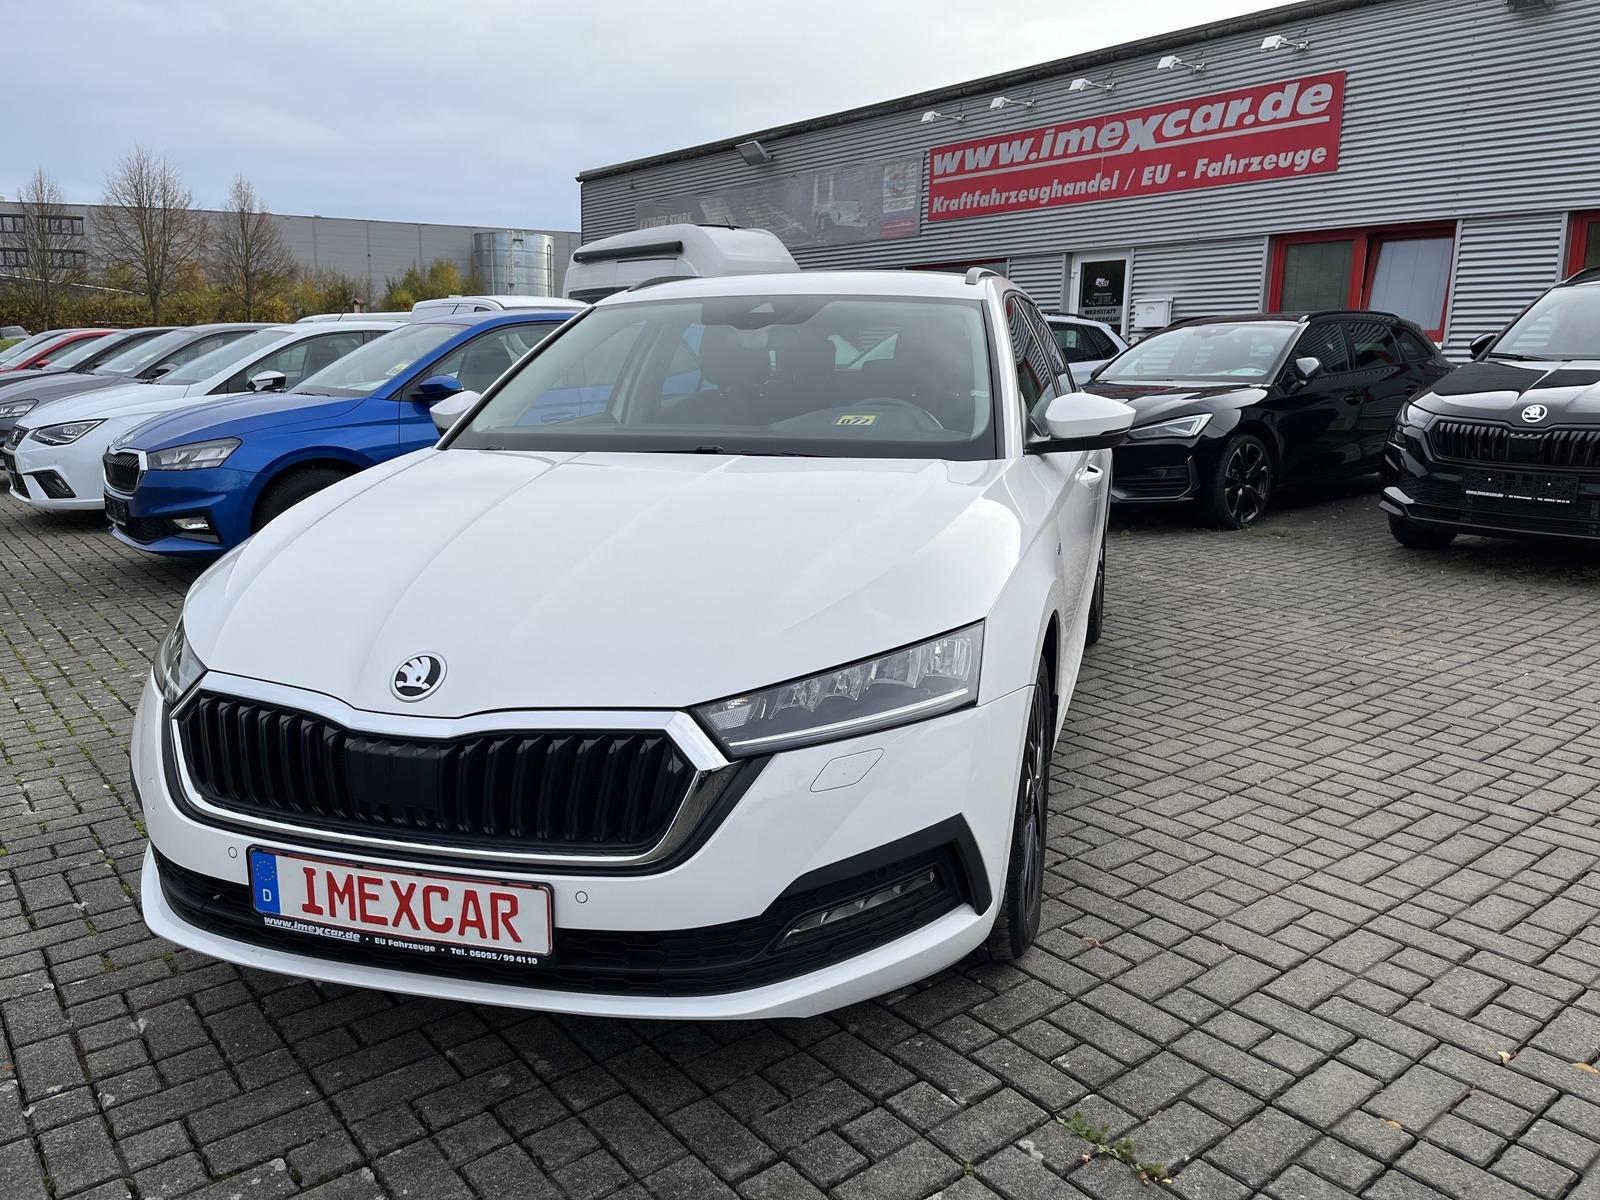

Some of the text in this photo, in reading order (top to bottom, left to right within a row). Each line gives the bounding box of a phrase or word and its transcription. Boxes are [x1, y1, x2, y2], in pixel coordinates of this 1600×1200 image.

[933, 83, 1333, 176] www.imexcar.de
[932, 170, 1120, 213] Kraftfahrzeughandel
[1141, 164, 1171, 186] EU
[1194, 147, 1327, 181] Fahrzeuge
[262, 888, 272, 902] D
[302, 866, 522, 943] IMEXCAR
[264, 917, 360, 942] www.imexcar.de
[374, 937, 386, 945] EU
[388, 939, 436, 952] Fahrzeuge
[450, 947, 467, 956] Tel.
